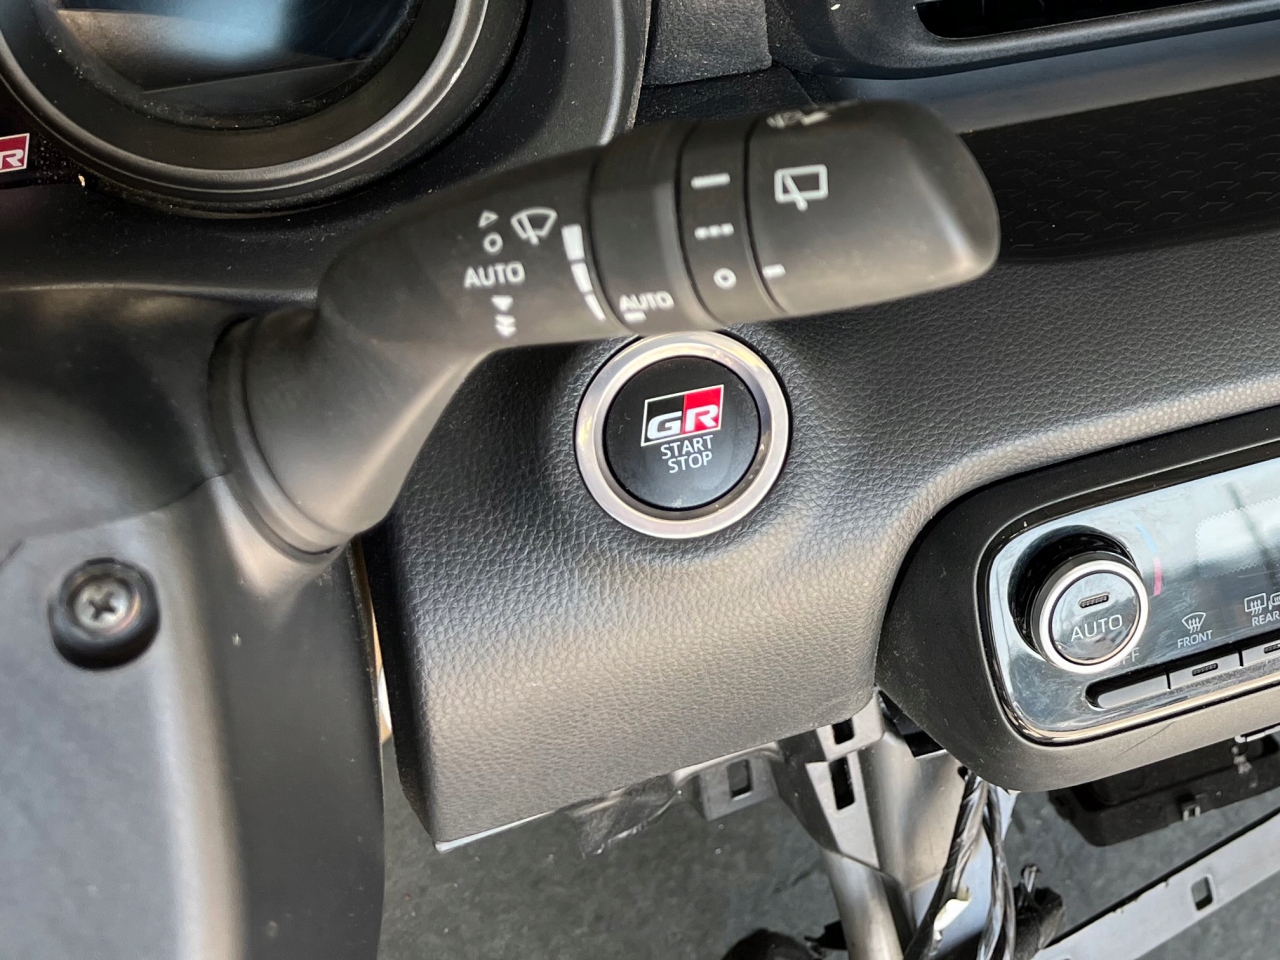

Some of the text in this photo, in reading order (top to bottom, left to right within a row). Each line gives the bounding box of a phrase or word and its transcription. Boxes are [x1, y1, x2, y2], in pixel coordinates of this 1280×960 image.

[0, 149, 24, 170] R
[464, 260, 526, 289] AUTO
[619, 290, 675, 312] AUTO
[647, 404, 719, 440] GR
[660, 434, 714, 459] START
[667, 451, 713, 474] STOP
[1070, 613, 1123, 642] AUTO
[1251, 610, 1280, 627] REAR
[1177, 629, 1213, 649] FRONT
